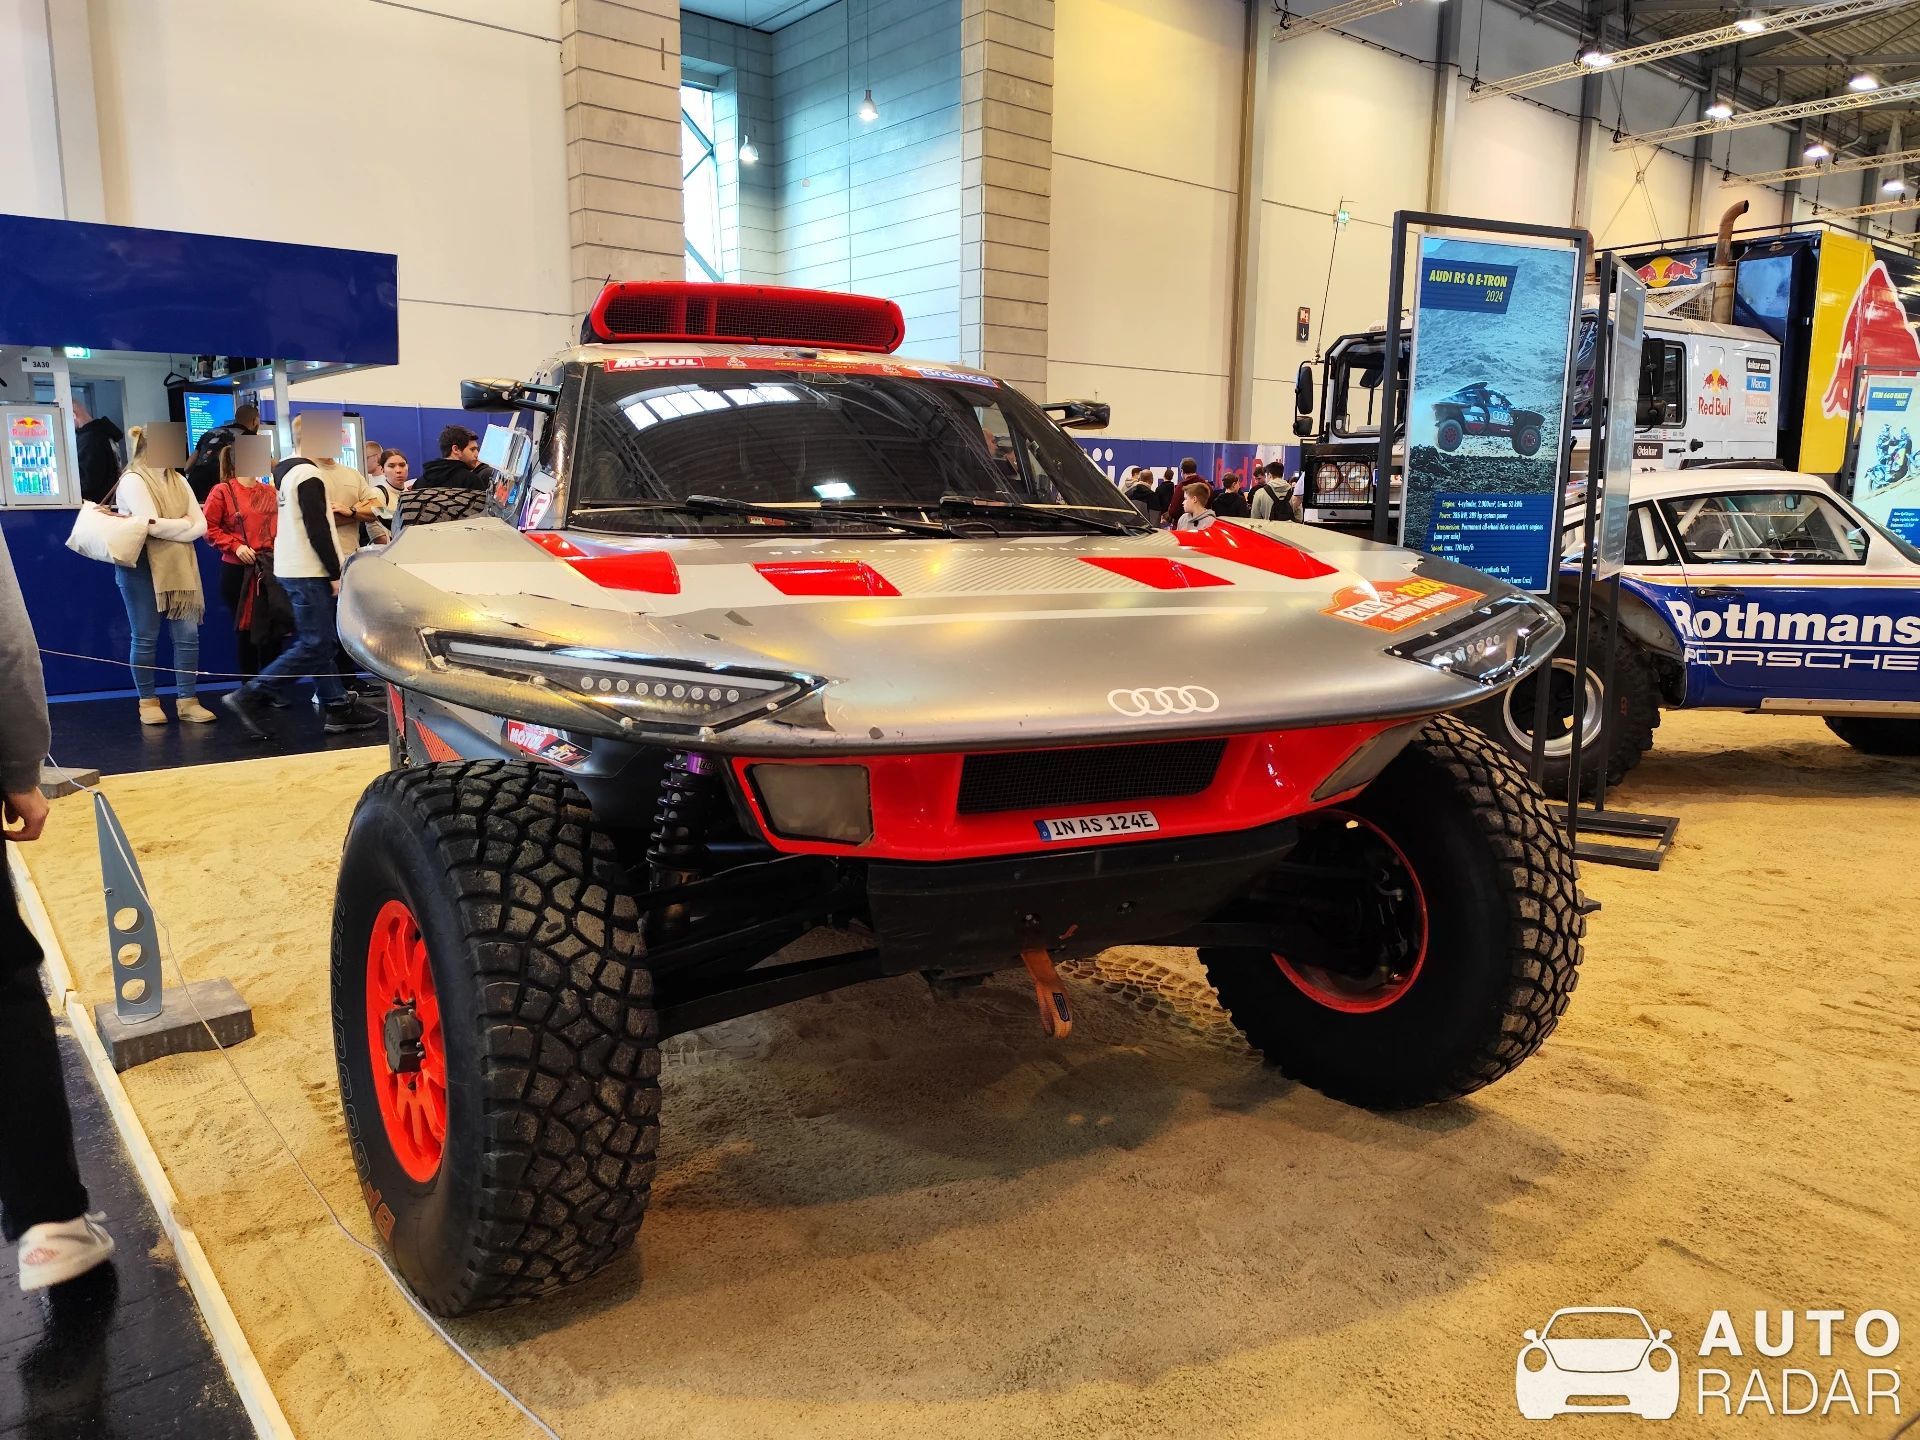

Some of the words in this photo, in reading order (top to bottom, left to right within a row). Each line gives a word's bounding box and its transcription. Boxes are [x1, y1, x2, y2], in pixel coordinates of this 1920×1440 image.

[1429, 270, 1453, 283] AUDI
[1454, 271, 1466, 284] RS
[1467, 273, 1475, 286] Q
[1476, 274, 1507, 288] E-TRON
[1485, 290, 1503, 302] 2024
[32, 361, 50, 369] 3A30
[613, 357, 699, 368] MOTUL
[922, 368, 991, 384] aramco
[1698, 396, 1715, 415] Red
[1715, 397, 1731, 416] Bull
[12, 428, 30, 437] Red
[31, 429, 48, 437] Bull
[1636, 445, 1658, 457] @dakar
[1665, 600, 1920, 644] Rothmans
[1683, 647, 1920, 671] PORSCHE
[510, 728, 546, 750] MOTUL
[1052, 820, 1076, 836] IN
[1079, 818, 1103, 834] AS
[1106, 813, 1154, 831] 124E
